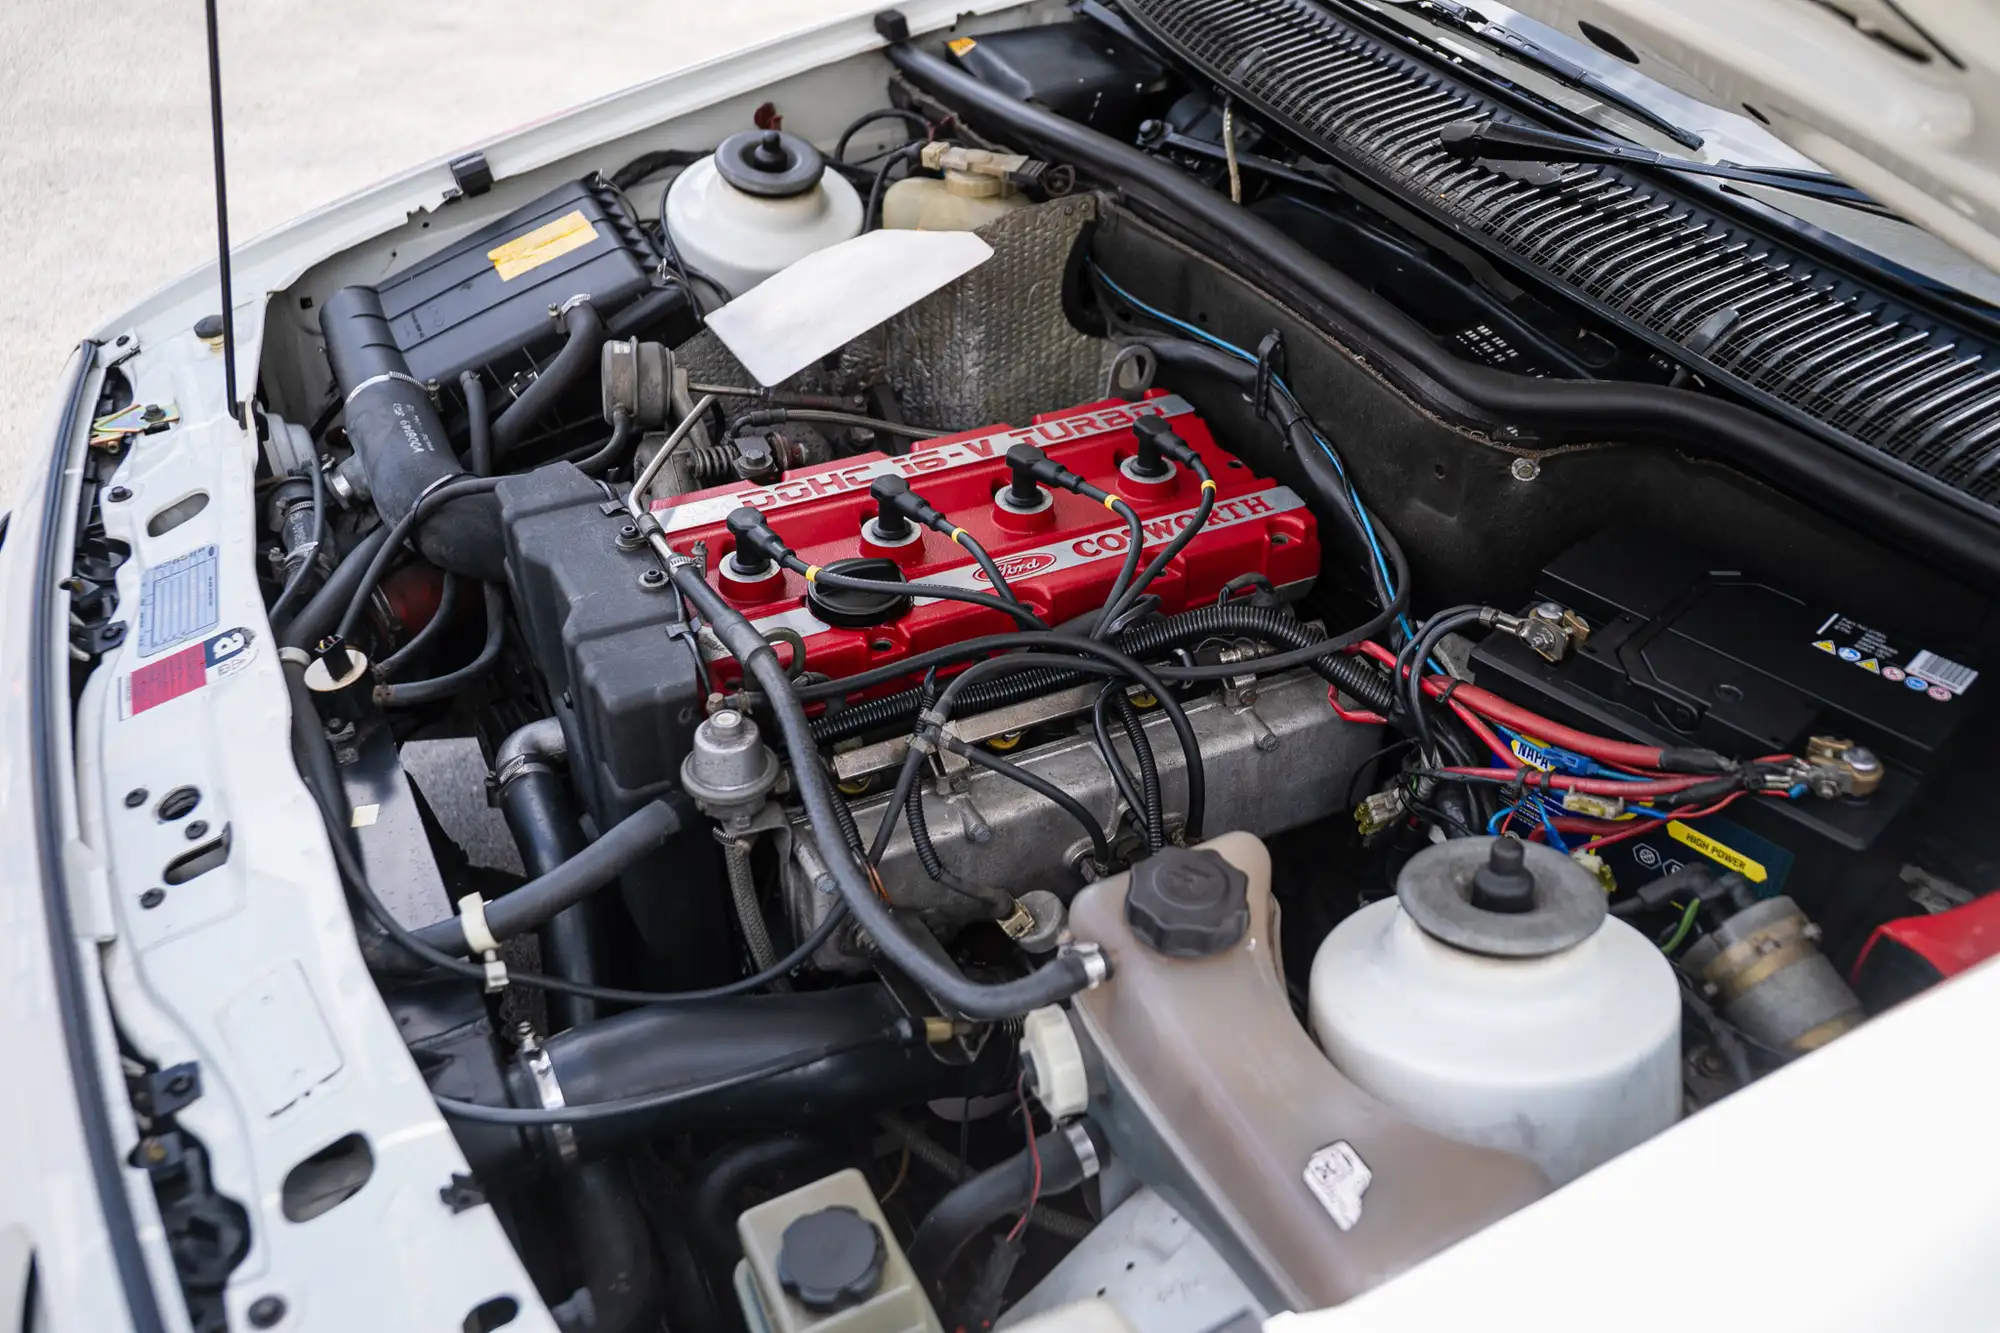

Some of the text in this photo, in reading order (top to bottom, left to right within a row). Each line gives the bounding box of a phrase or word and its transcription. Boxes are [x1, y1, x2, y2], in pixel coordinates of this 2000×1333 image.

[737, 466, 874, 510] DOHC
[1008, 402, 1165, 446] TURBO
[996, 557, 1040, 577] Ford
[1518, 743, 1549, 770] NAPA
[1686, 832, 1747, 870] HIGH POWER
